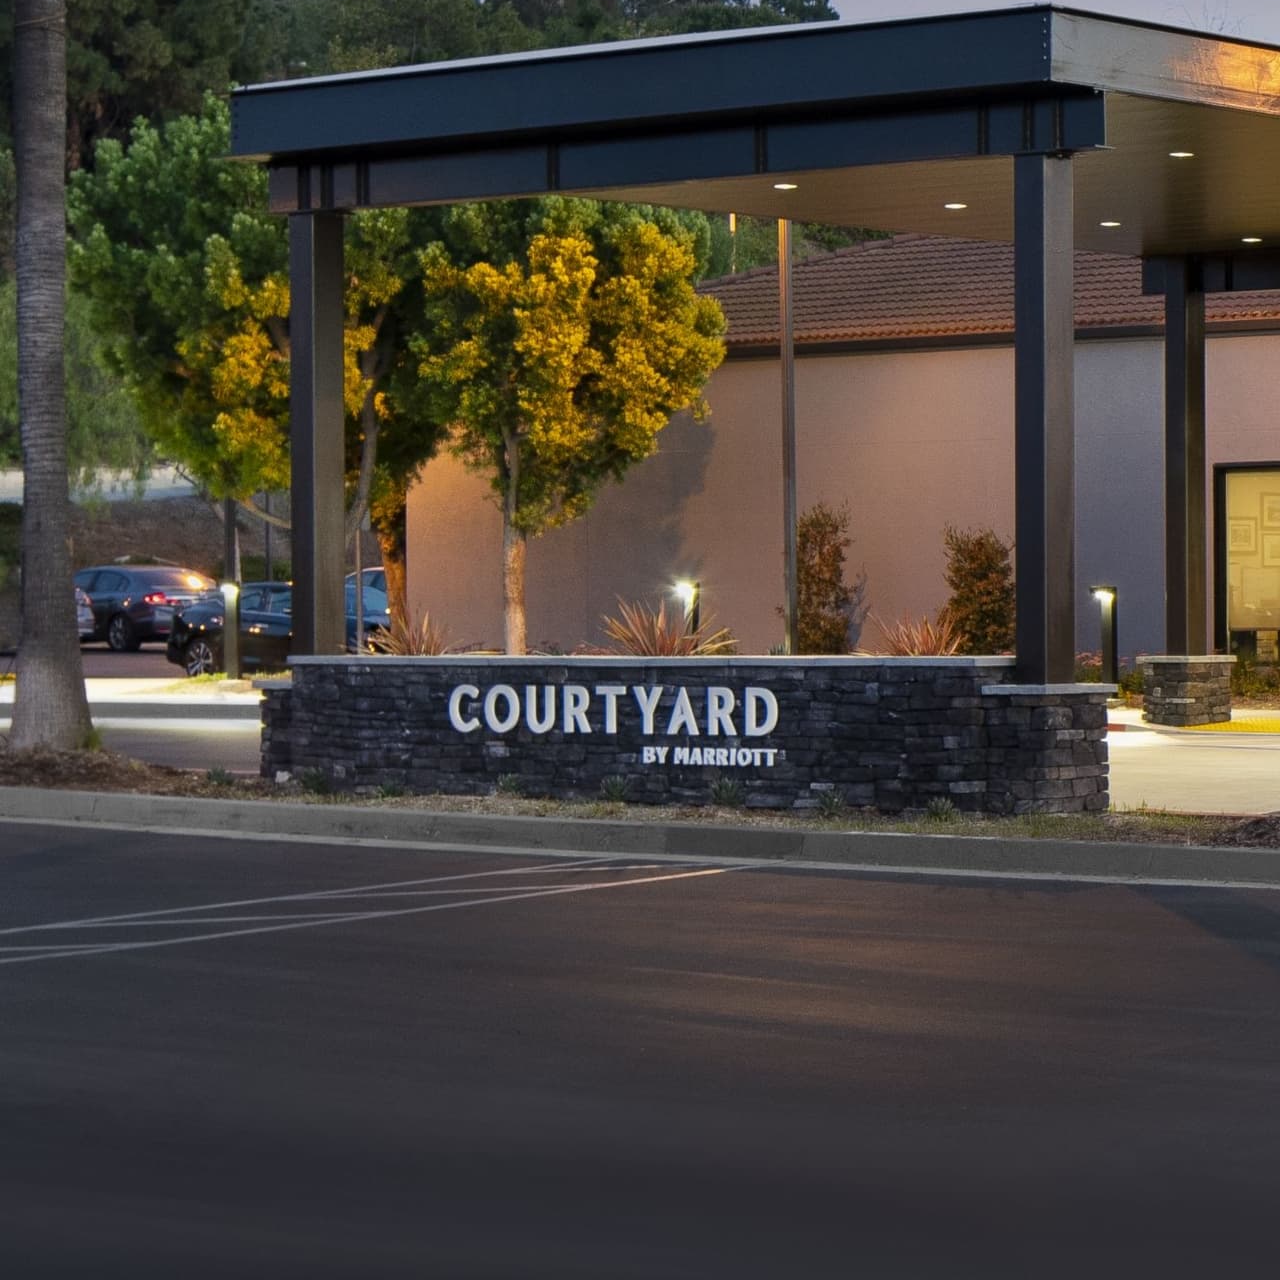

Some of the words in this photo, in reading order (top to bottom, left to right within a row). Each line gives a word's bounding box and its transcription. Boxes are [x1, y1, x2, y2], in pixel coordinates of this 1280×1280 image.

[449, 684, 779, 736] COURTYARD
[642, 746, 669, 764] BY
[673, 746, 778, 767] MARRIOTT
